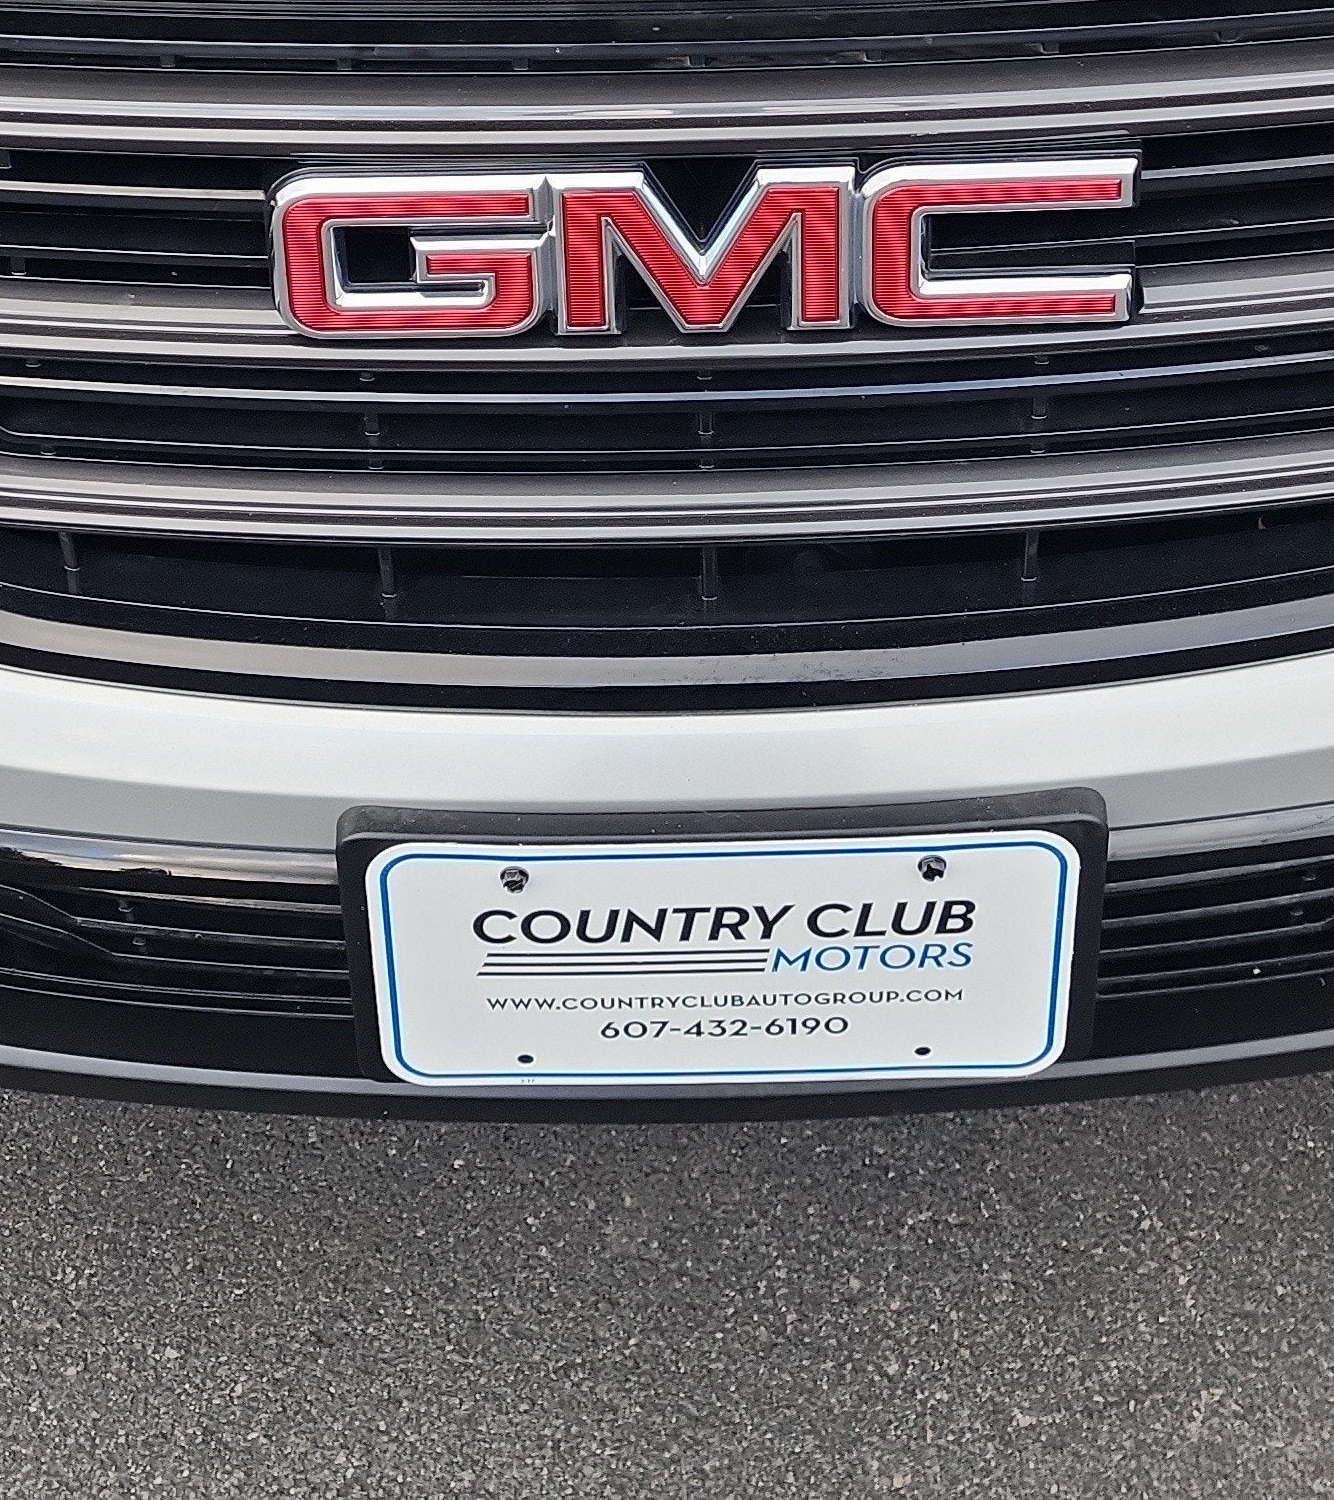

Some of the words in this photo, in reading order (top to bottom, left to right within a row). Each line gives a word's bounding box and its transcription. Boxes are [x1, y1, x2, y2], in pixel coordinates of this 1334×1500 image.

[271, 156, 1140, 339] GMC
[472, 903, 796, 944] COUNTRY
[806, 899, 976, 938] CLUB
[771, 942, 974, 973] MOTORS
[486, 988, 964, 1011] WWW.COUNTRYCLUBAUTOGROUP.COM
[600, 1016, 850, 1039] 607-432-6190
